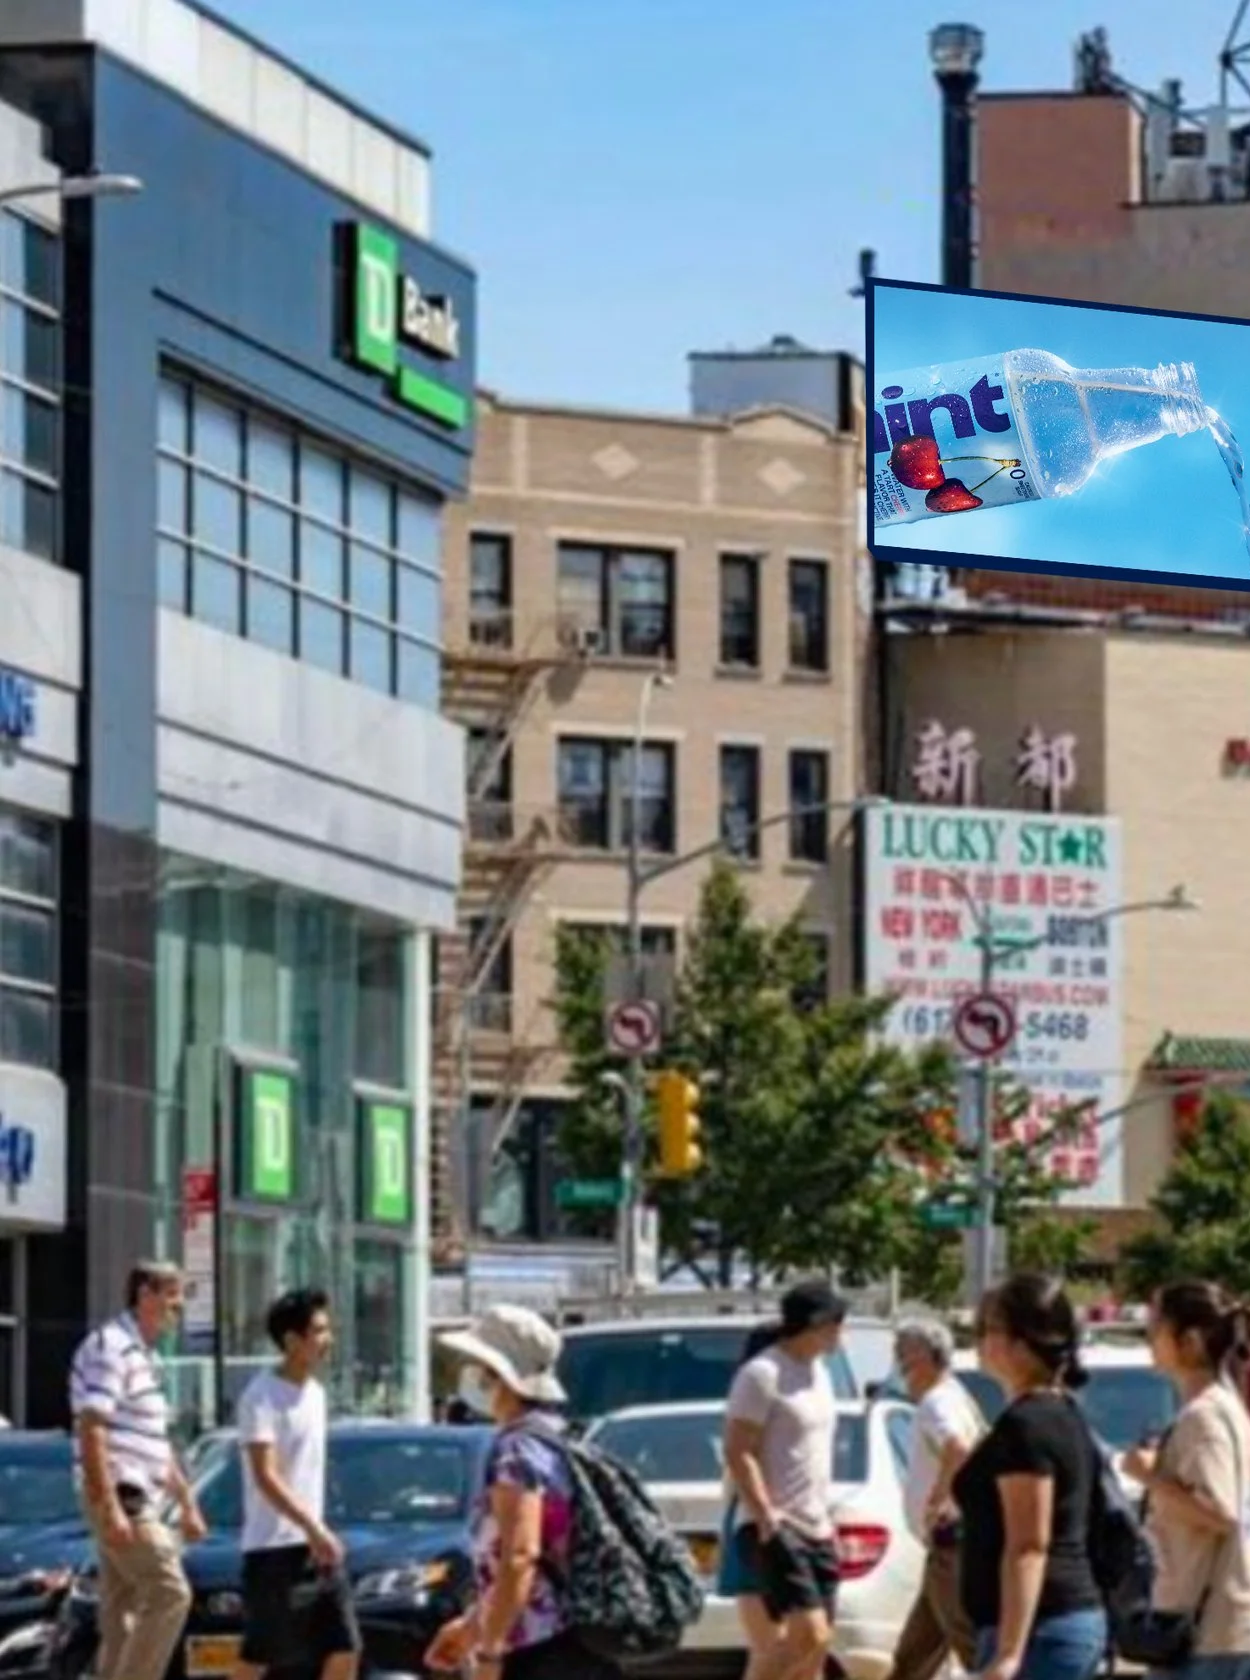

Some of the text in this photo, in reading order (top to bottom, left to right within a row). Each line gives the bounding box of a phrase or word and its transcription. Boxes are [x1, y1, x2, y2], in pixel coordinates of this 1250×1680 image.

[361, 252, 460, 359] TD Bank
[874, 374, 1012, 453] int
[912, 717, 1077, 815] 新都
[883, 813, 1005, 863] LUCKY
[256, 1096, 291, 1170] TD
[374, 1126, 406, 1195] TD
